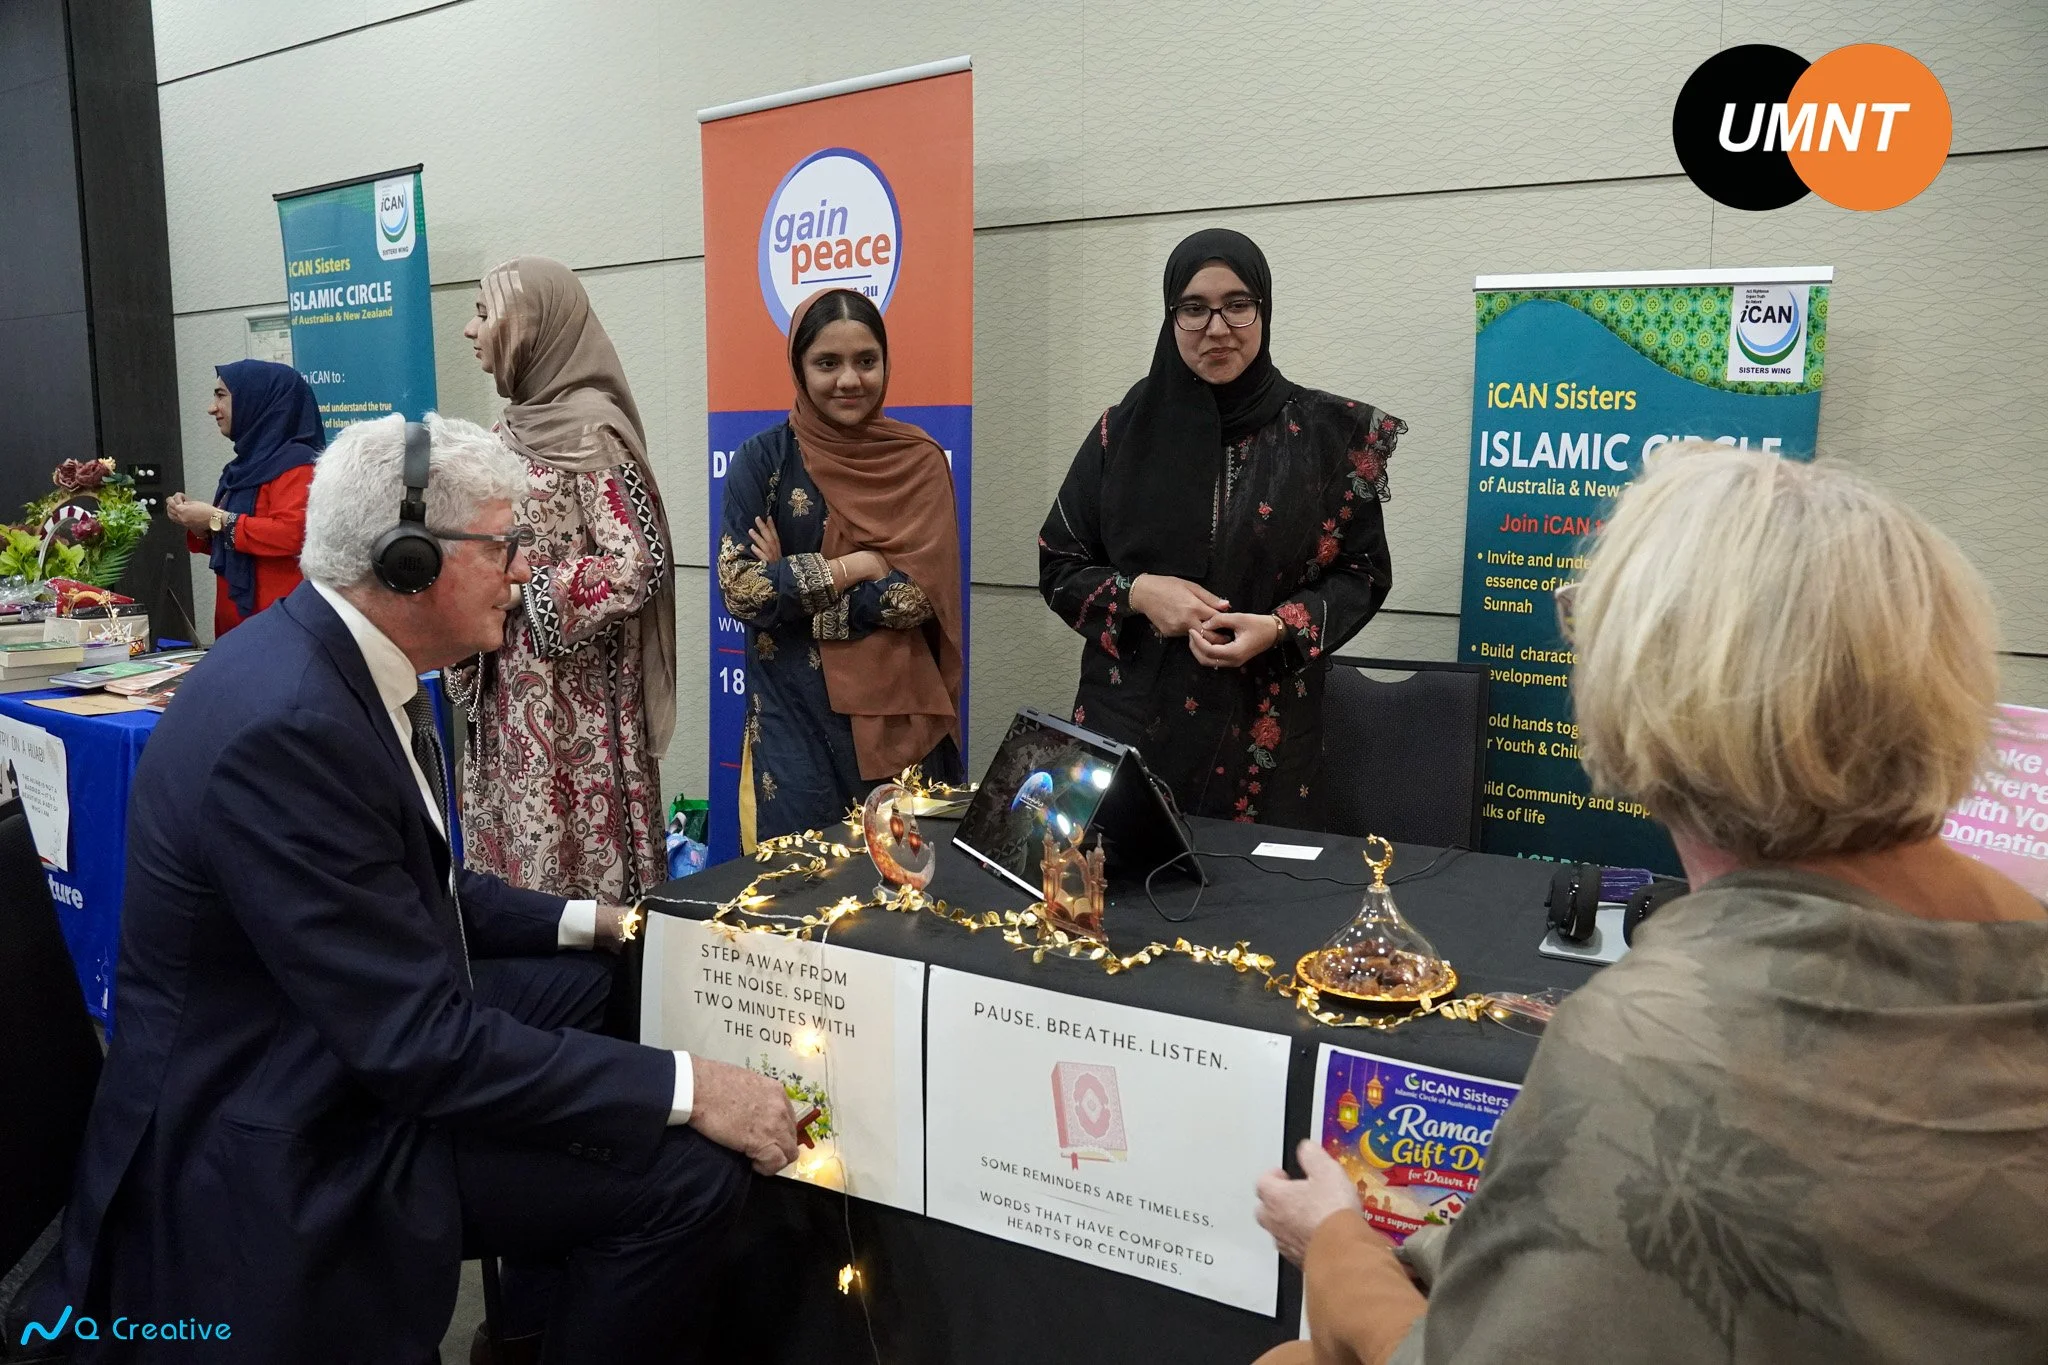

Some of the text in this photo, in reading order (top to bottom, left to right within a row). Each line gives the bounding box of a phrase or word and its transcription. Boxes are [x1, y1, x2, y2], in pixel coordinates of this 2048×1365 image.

[381, 195, 404, 212] iCAN
[773, 199, 848, 254] gain
[288, 257, 350, 278] iCAN Sisters
[791, 233, 892, 285] peace
[290, 280, 392, 312] ISLAMIC CIRCLE
[292, 306, 392, 326] of Australia & New Zealand
[1740, 304, 1792, 324] iCAN
[310, 370, 330, 384] iCAN
[1739, 366, 1770, 374] SISTERS
[332, 402, 367, 412] understand
[368, 400, 379, 411] the
[380, 402, 392, 411] true
[1487, 382, 1638, 412] iCAN Sisters
[1479, 430, 1631, 472] ISLAMIC
[1479, 476, 1620, 498] of Australia & New
[1500, 513, 1538, 533] Join
[1544, 514, 1590, 536] iCAN
[1487, 550, 1525, 566] Invite
[1527, 553, 1553, 568] and
[1486, 576, 1538, 591] essence
[1541, 577, 1556, 592] of
[1484, 596, 1533, 614] Sunnah
[1481, 642, 1514, 659] Build
[720, 666, 746, 695] 18
[1512, 714, 1554, 733] hands
[1496, 736, 1535, 754] Youth
[1538, 741, 1548, 756] &
[1507, 784, 1586, 810] Community
[1588, 796, 1614, 811] and
[1507, 808, 1521, 821] of
[1524, 808, 1546, 825] life
[701, 943, 848, 987] STEP AWAY FROM
[702, 968, 846, 1010] THE NOISE. SPEND
[694, 990, 856, 1038] TWO MINUTES WITH
[724, 1019, 754, 1038] THE
[974, 1002, 1228, 1071] PAUSE. BREATHE. LISTEN.
[1418, 1092, 1438, 1104] Circle
[1446, 1098, 1476, 1112] Australia
[1462, 1088, 1509, 1108] Sisters
[1392, 1138, 1446, 1169] Gift
[1408, 1168, 1422, 1181] for
[1423, 1170, 1464, 1188] Dawn
[980, 1156, 1214, 1228] SOME REMINDERS ARE TIMELESS.
[980, 1190, 1214, 1266] WORDS THAT HAVE COMFORTED
[1374, 1214, 1386, 1222] us
[1007, 1216, 1182, 1276] HEARTS FOR CENTURIES.
